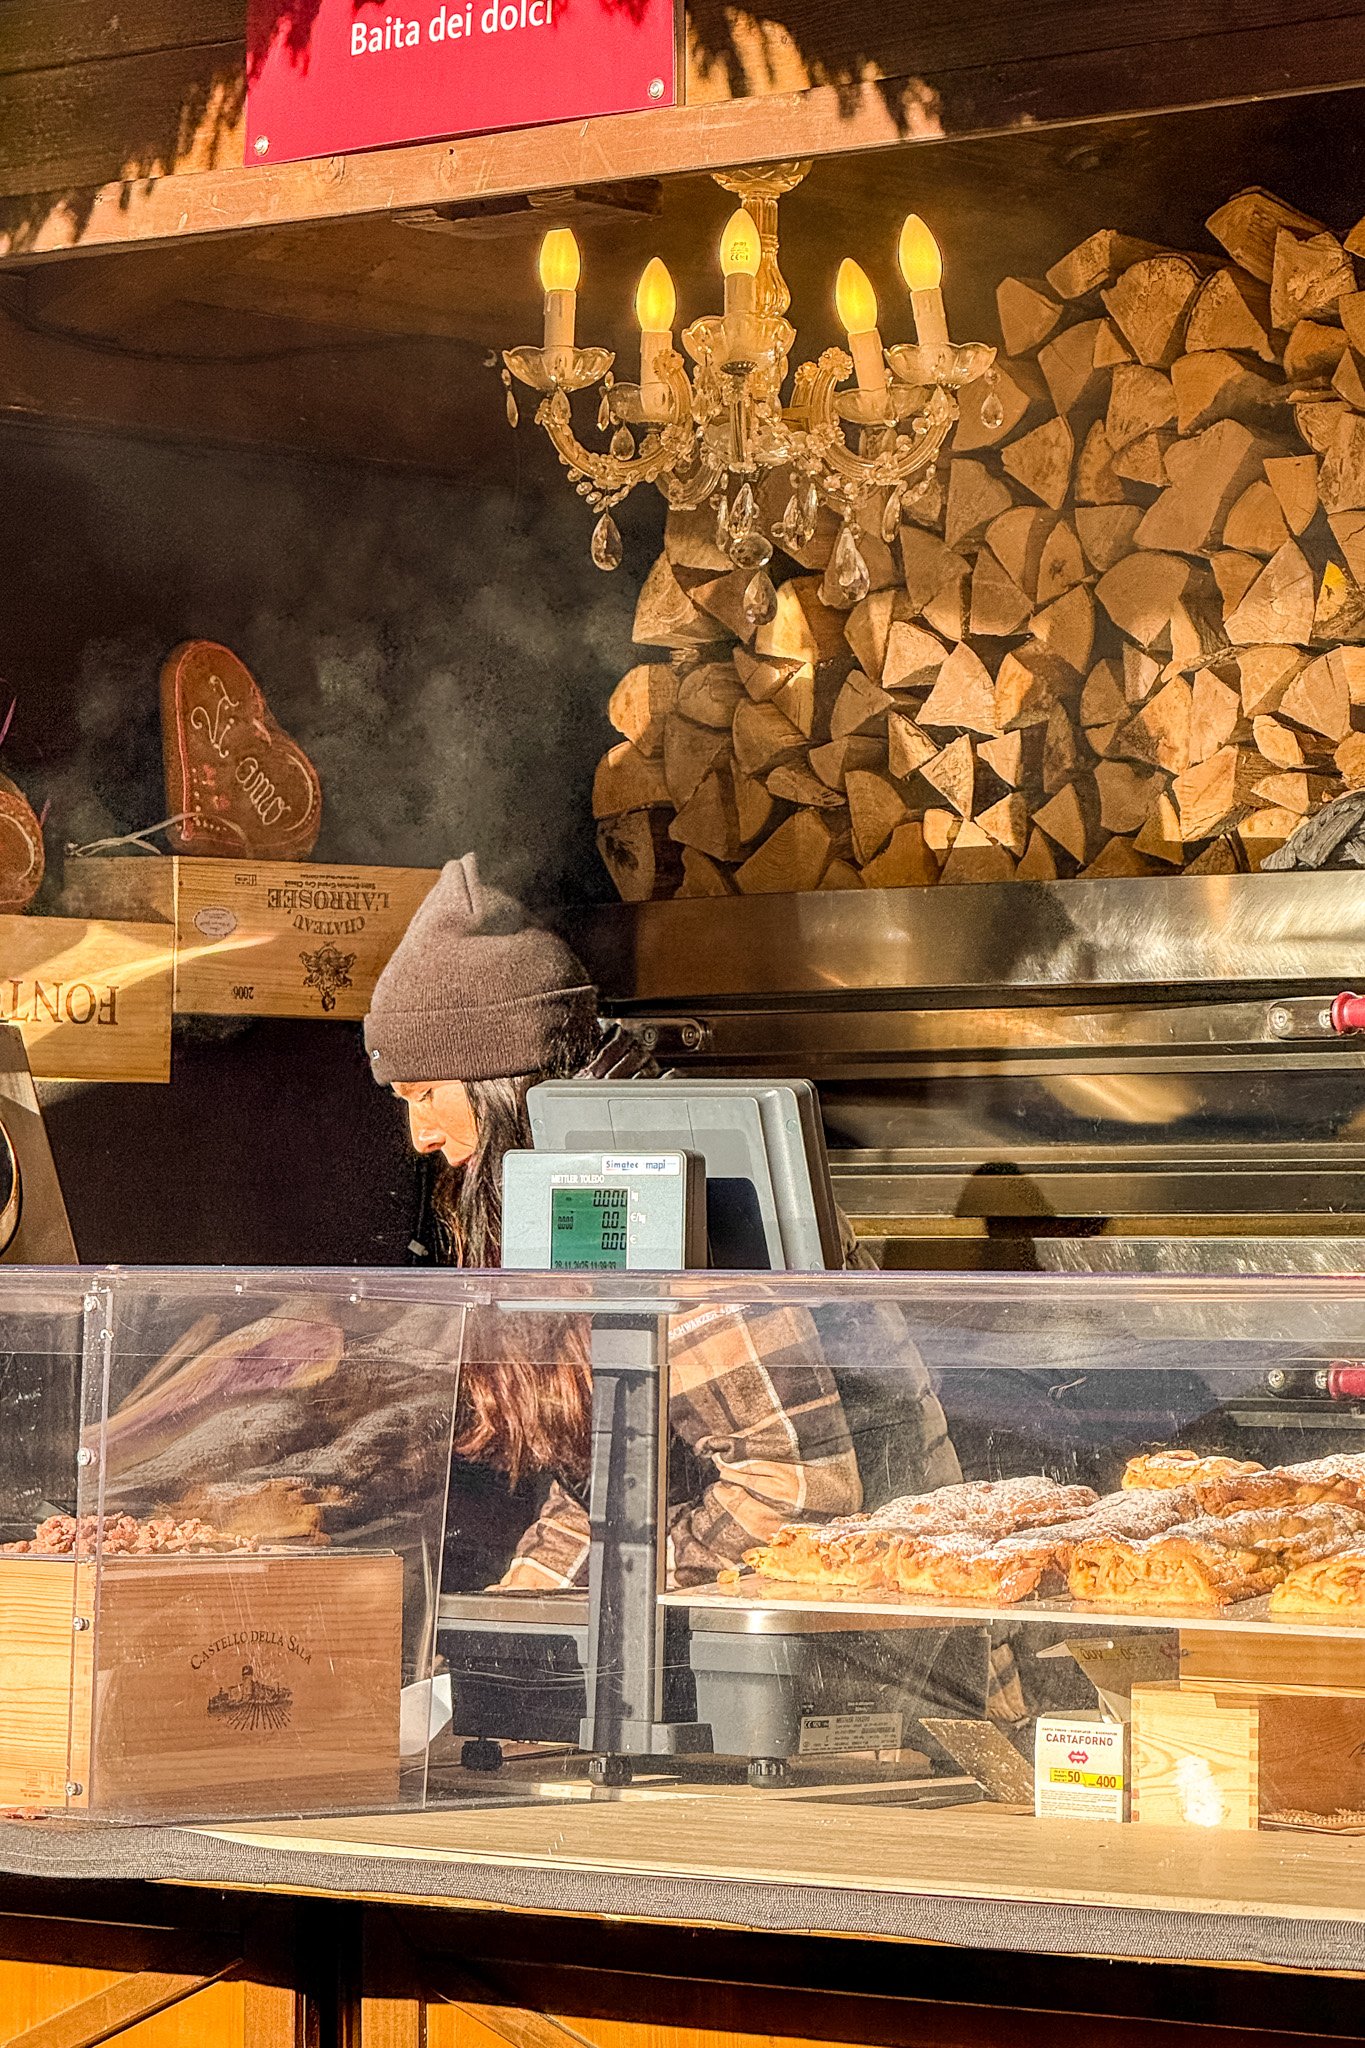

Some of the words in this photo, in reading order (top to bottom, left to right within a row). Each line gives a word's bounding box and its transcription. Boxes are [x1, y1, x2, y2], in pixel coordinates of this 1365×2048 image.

[350, 16, 421, 56] Baita
[428, 3, 473, 43] dei
[481, 0, 553, 34] dolci
[266, 888, 390, 914] L'ARROSÉE
[232, 985, 255, 1000] 2006
[606, 1160, 638, 1169] Simatec
[646, 1159, 666, 1171] mapi
[551, 1175, 578, 1183] METTLER
[580, 1175, 604, 1183] TOLEDO
[630, 1234, 637, 1244] €
[190, 1631, 248, 1670] CASTELLO
[251, 1630, 284, 1647] DELLA
[287, 1635, 313, 1665] SALA
[1046, 1733, 1113, 1746] CARTAFORNO
[1067, 1770, 1081, 1783] 50
[1096, 1775, 1116, 1788] 400
